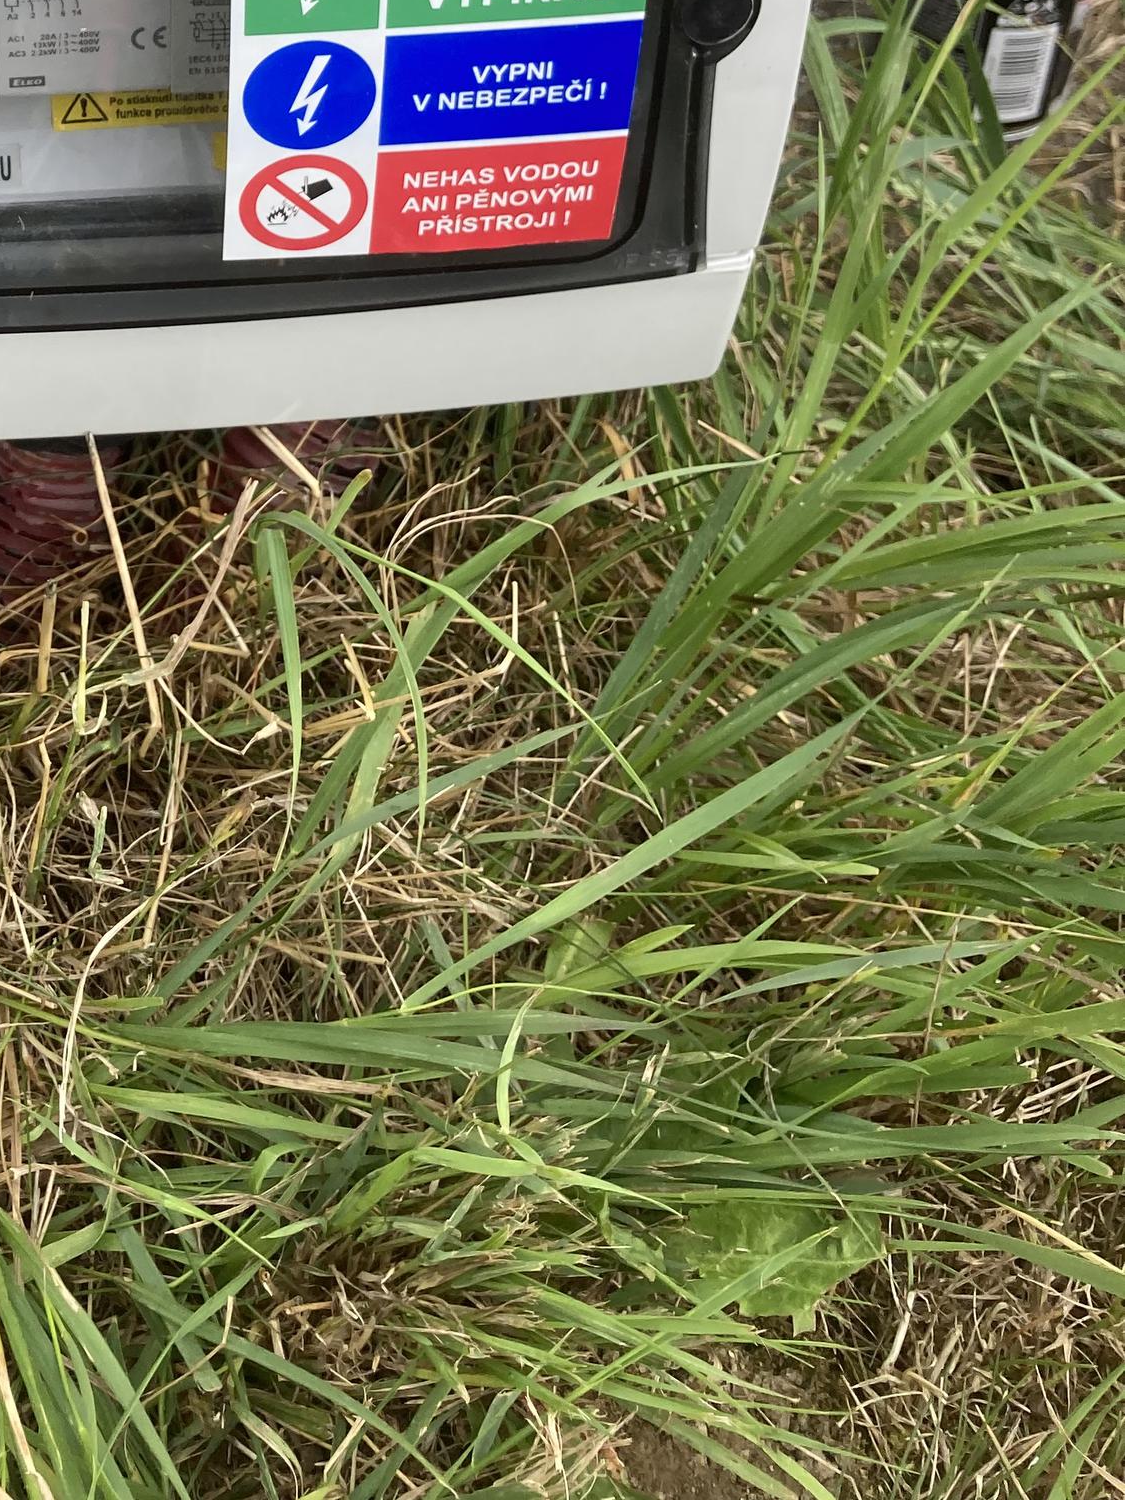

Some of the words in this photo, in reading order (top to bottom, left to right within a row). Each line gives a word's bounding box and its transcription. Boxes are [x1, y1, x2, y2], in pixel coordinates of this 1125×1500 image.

[472, 60, 553, 84] VYPNI
[109, 96, 124, 106] Po
[412, 94, 431, 112] V
[438, 80, 595, 110] NEBEZPEČÍ
[599, 81, 607, 99] !
[116, 107, 151, 119] funkce
[402, 166, 495, 189] NEHAS
[503, 159, 600, 181] VODOU
[401, 193, 448, 214] ANI
[457, 184, 594, 210] PĚNOVÝMI
[417, 211, 556, 237] PŘÍSTROJI
[563, 209, 571, 226] !
